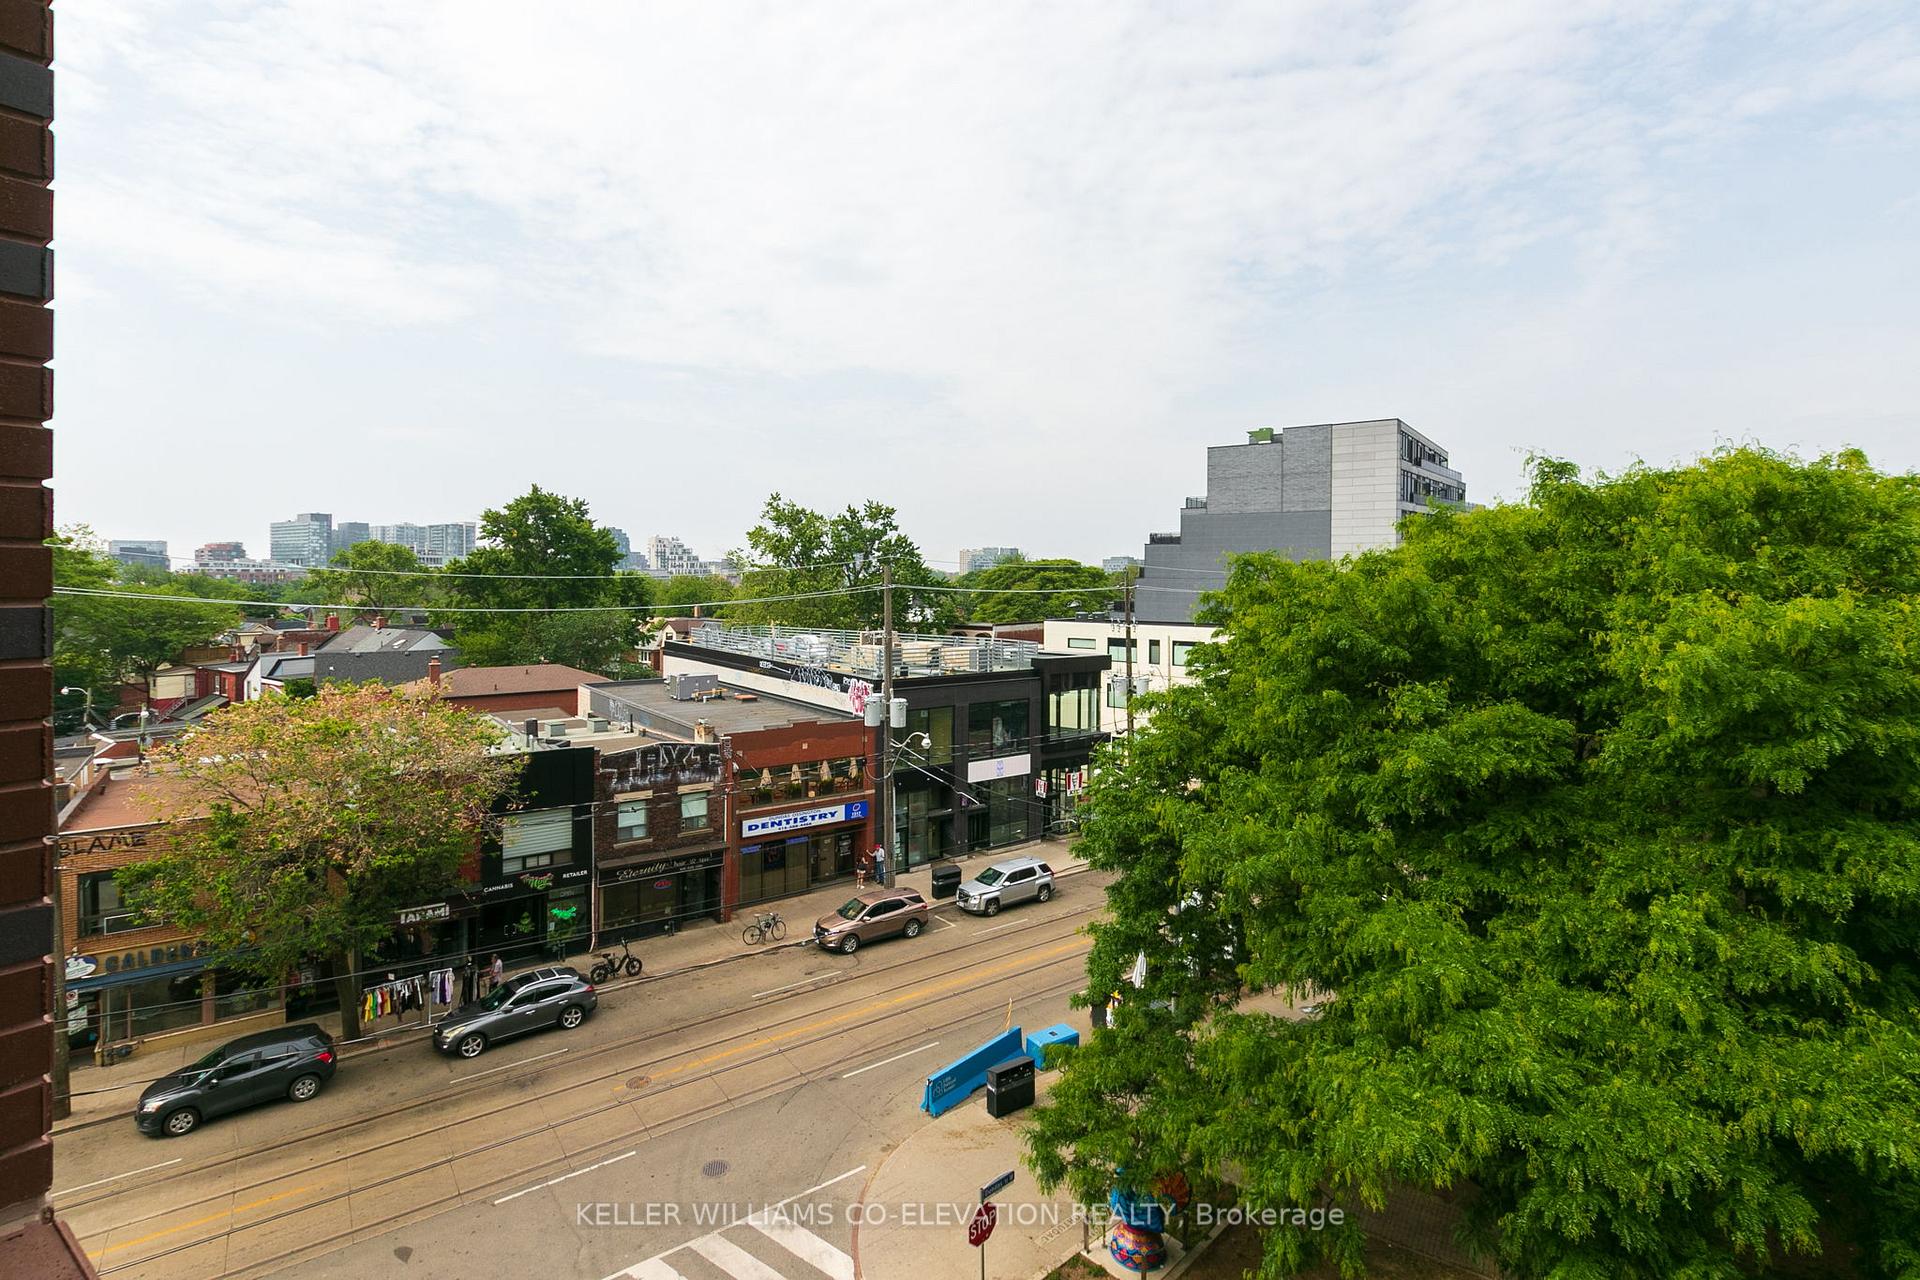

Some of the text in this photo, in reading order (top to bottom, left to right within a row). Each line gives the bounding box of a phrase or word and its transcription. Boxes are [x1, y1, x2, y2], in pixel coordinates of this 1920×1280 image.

[747, 810, 838, 832] DENTISTRY
[58, 831, 148, 858] BLAME
[562, 869, 588, 880] RETAILER
[483, 882, 514, 894] CANNABIS
[970, 1210, 996, 1240] STOP
